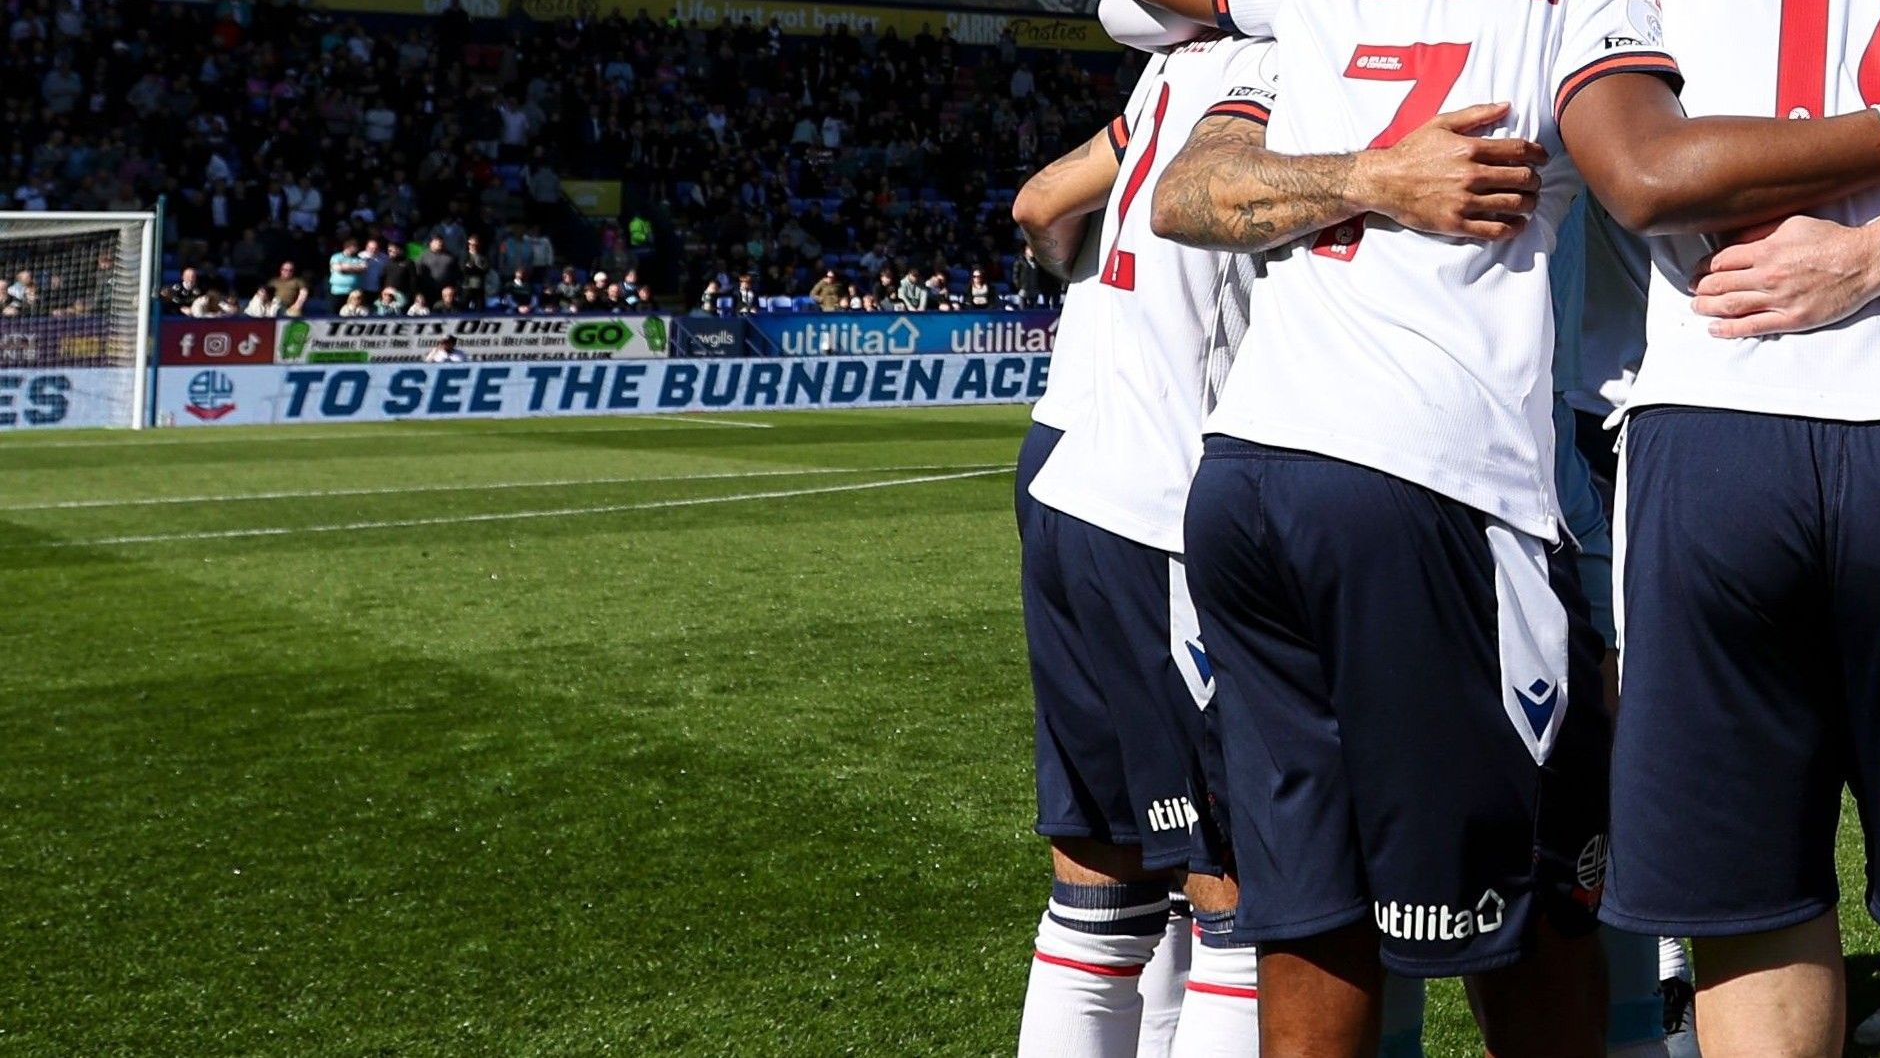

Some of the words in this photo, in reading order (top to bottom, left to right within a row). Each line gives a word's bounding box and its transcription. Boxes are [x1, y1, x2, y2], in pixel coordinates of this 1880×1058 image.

[1011, 19, 1087, 41] Pasties
[572, 324, 624, 346] GO
[781, 322, 885, 355] utilita
[951, 322, 1046, 354] utilita
[284, 369, 370, 419] TO
[383, 366, 512, 415] SEE
[526, 360, 647, 412] THE
[658, 358, 945, 407] BURNDEN
[952, 356, 1052, 400] ACE
[1374, 900, 1474, 941] utilita
